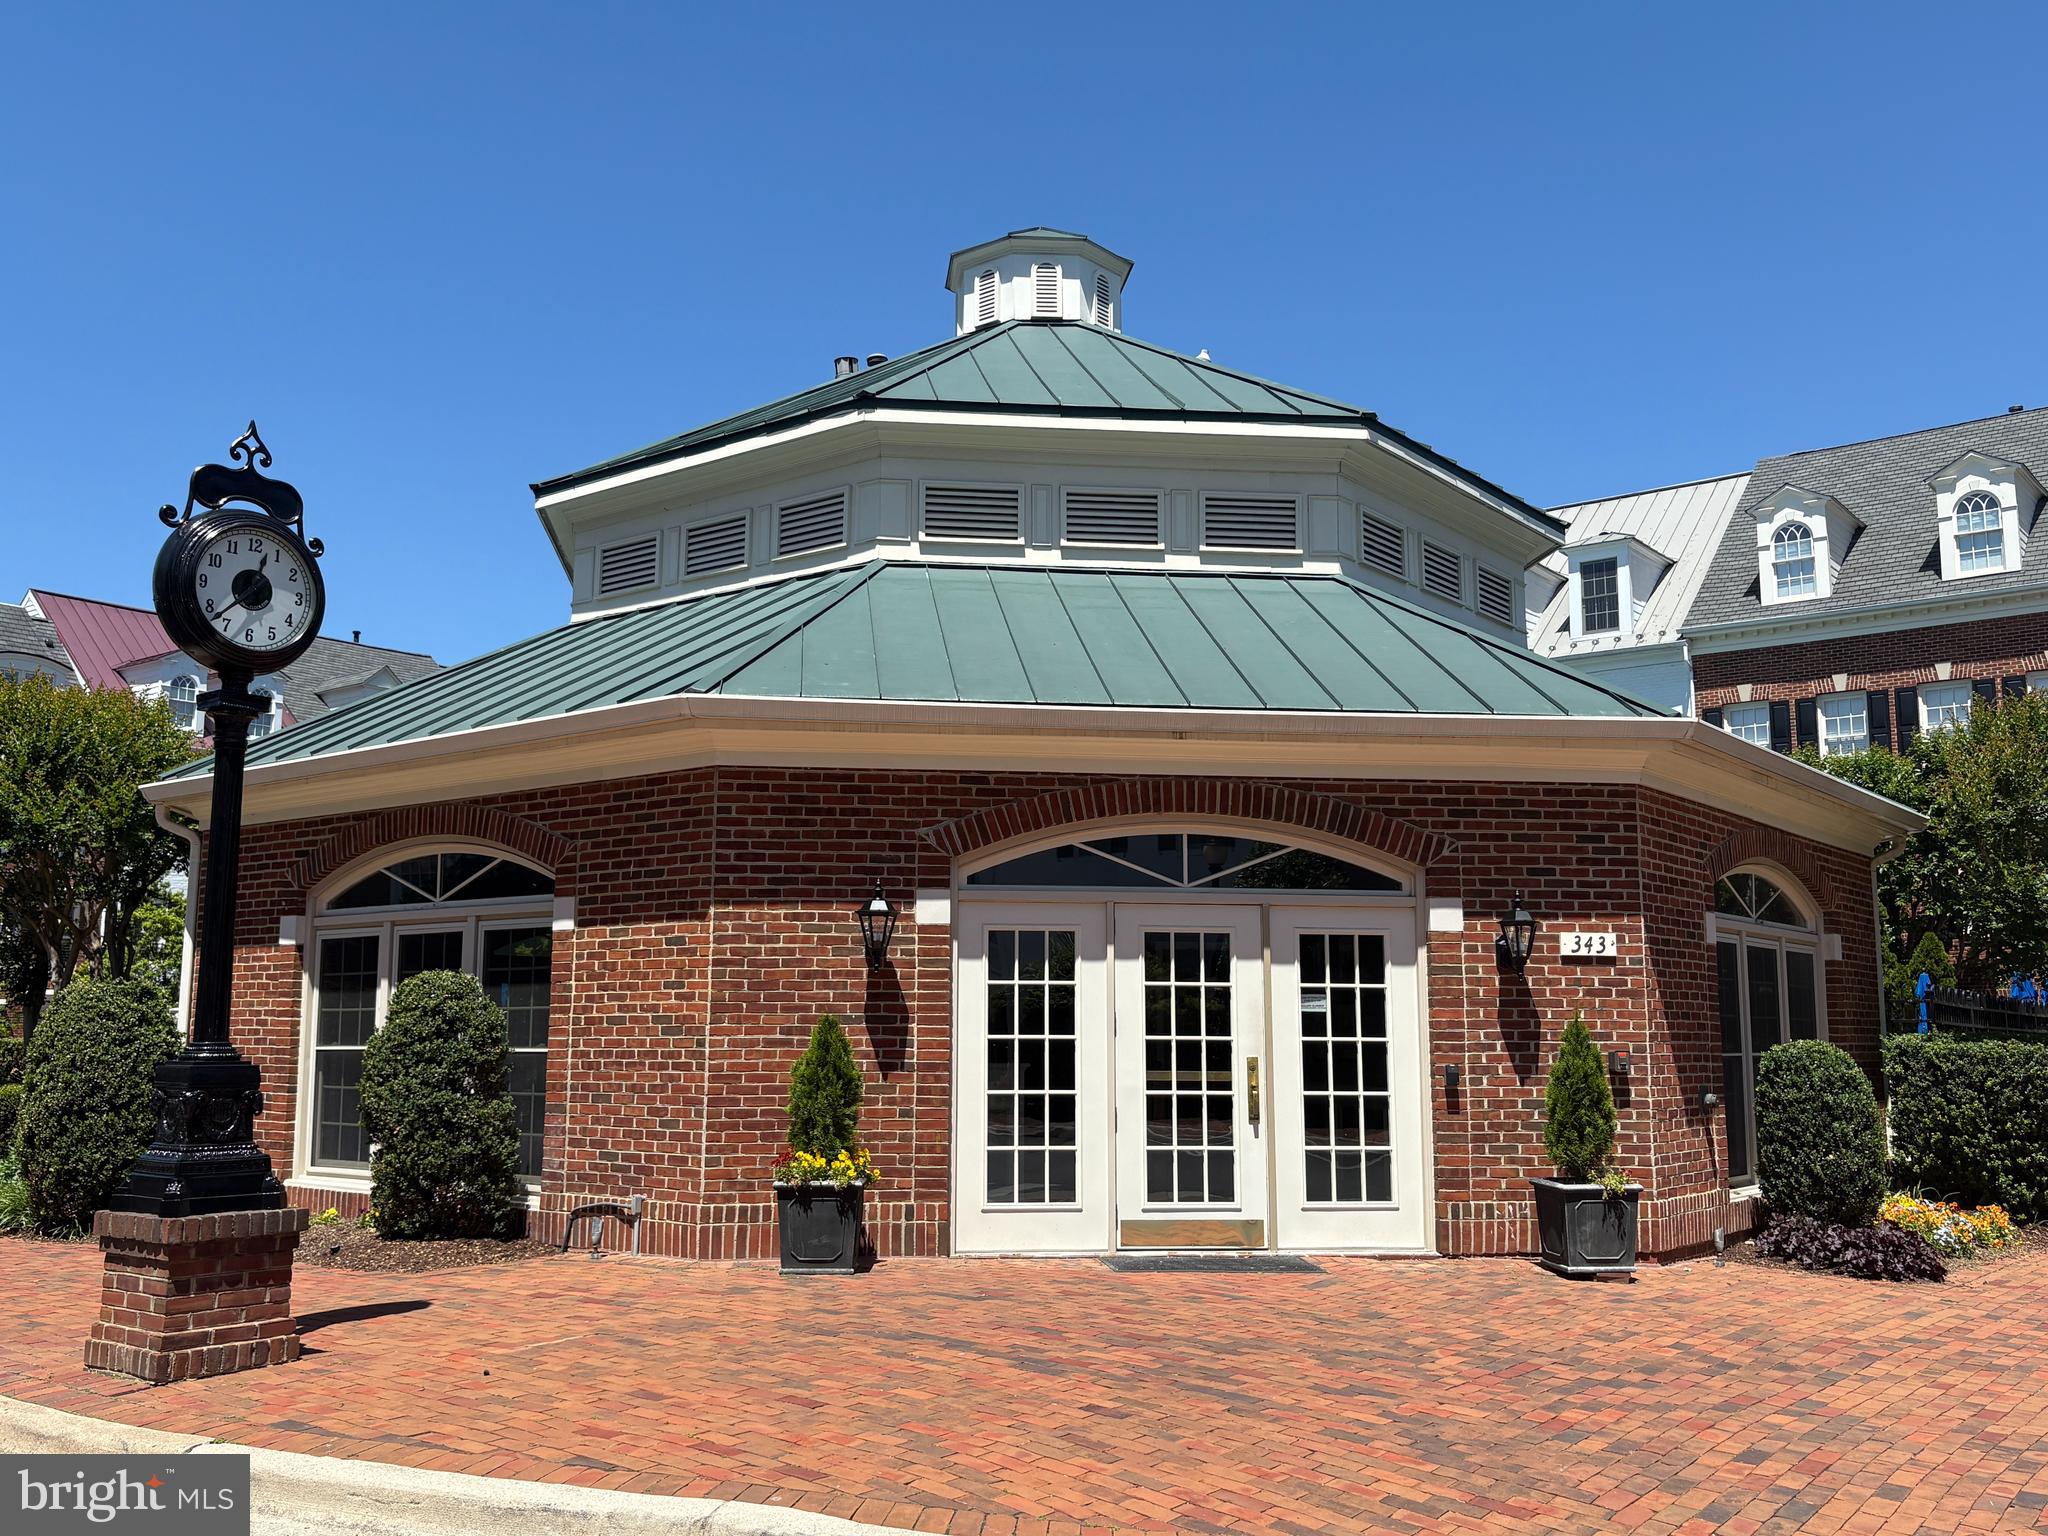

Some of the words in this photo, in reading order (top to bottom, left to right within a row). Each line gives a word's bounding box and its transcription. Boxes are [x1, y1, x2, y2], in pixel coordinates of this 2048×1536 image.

[226, 539, 238, 555] 11
[248, 538, 263, 553] 12
[208, 553, 222, 568] 10
[274, 549, 280, 563] 1
[199, 573, 207, 588] 9
[289, 568, 298, 582] 2
[205, 598, 214, 613] 8
[295, 592, 303, 606] 3
[222, 617, 231, 632] 7
[284, 613, 293, 627] 4
[245, 628, 253, 642] 6
[268, 626, 276, 641] 5
[1571, 935, 1606, 954] 343
